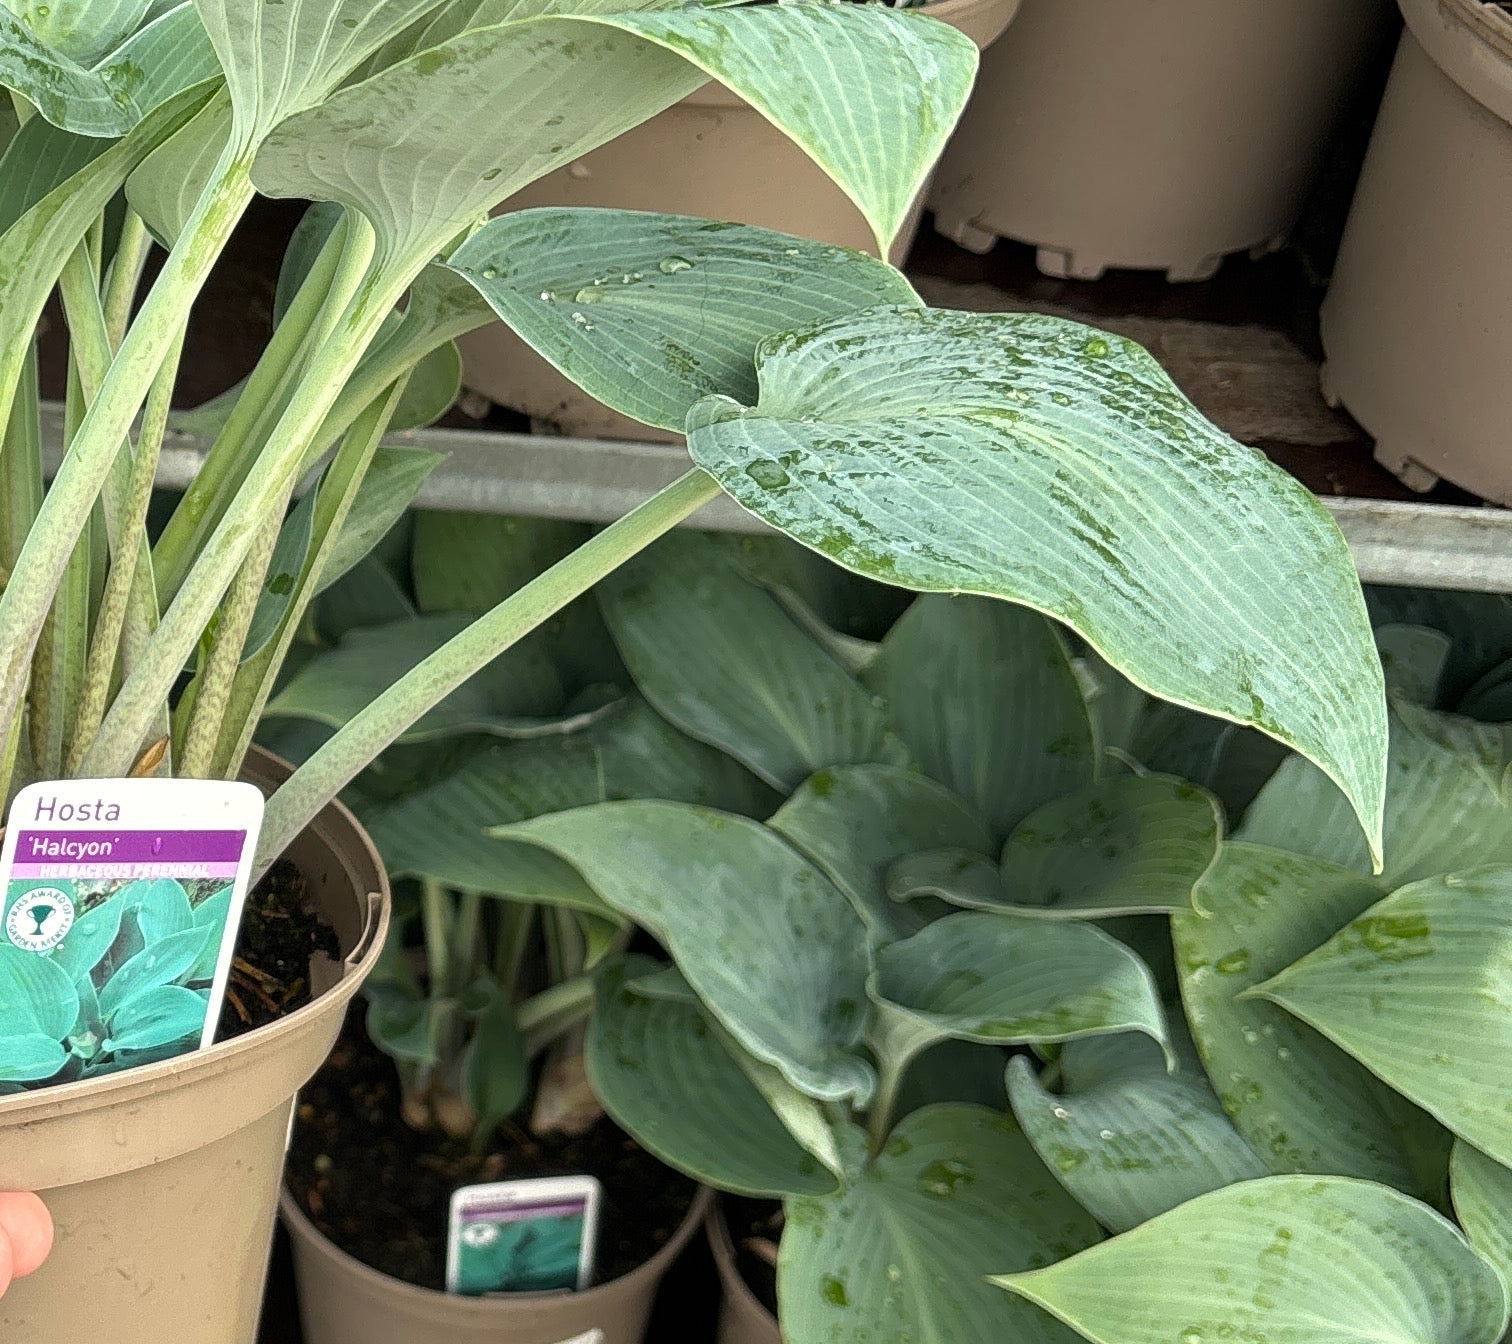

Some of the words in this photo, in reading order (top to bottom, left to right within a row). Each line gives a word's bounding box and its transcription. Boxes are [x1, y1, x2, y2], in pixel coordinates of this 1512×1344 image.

[34, 796, 121, 822] Hosta
[28, 836, 120, 860] 'Halcyon'
[39, 864, 130, 877] HERBACEOUS
[133, 864, 210, 877] PERENNIAL
[30, 890, 66, 904] AWARD
